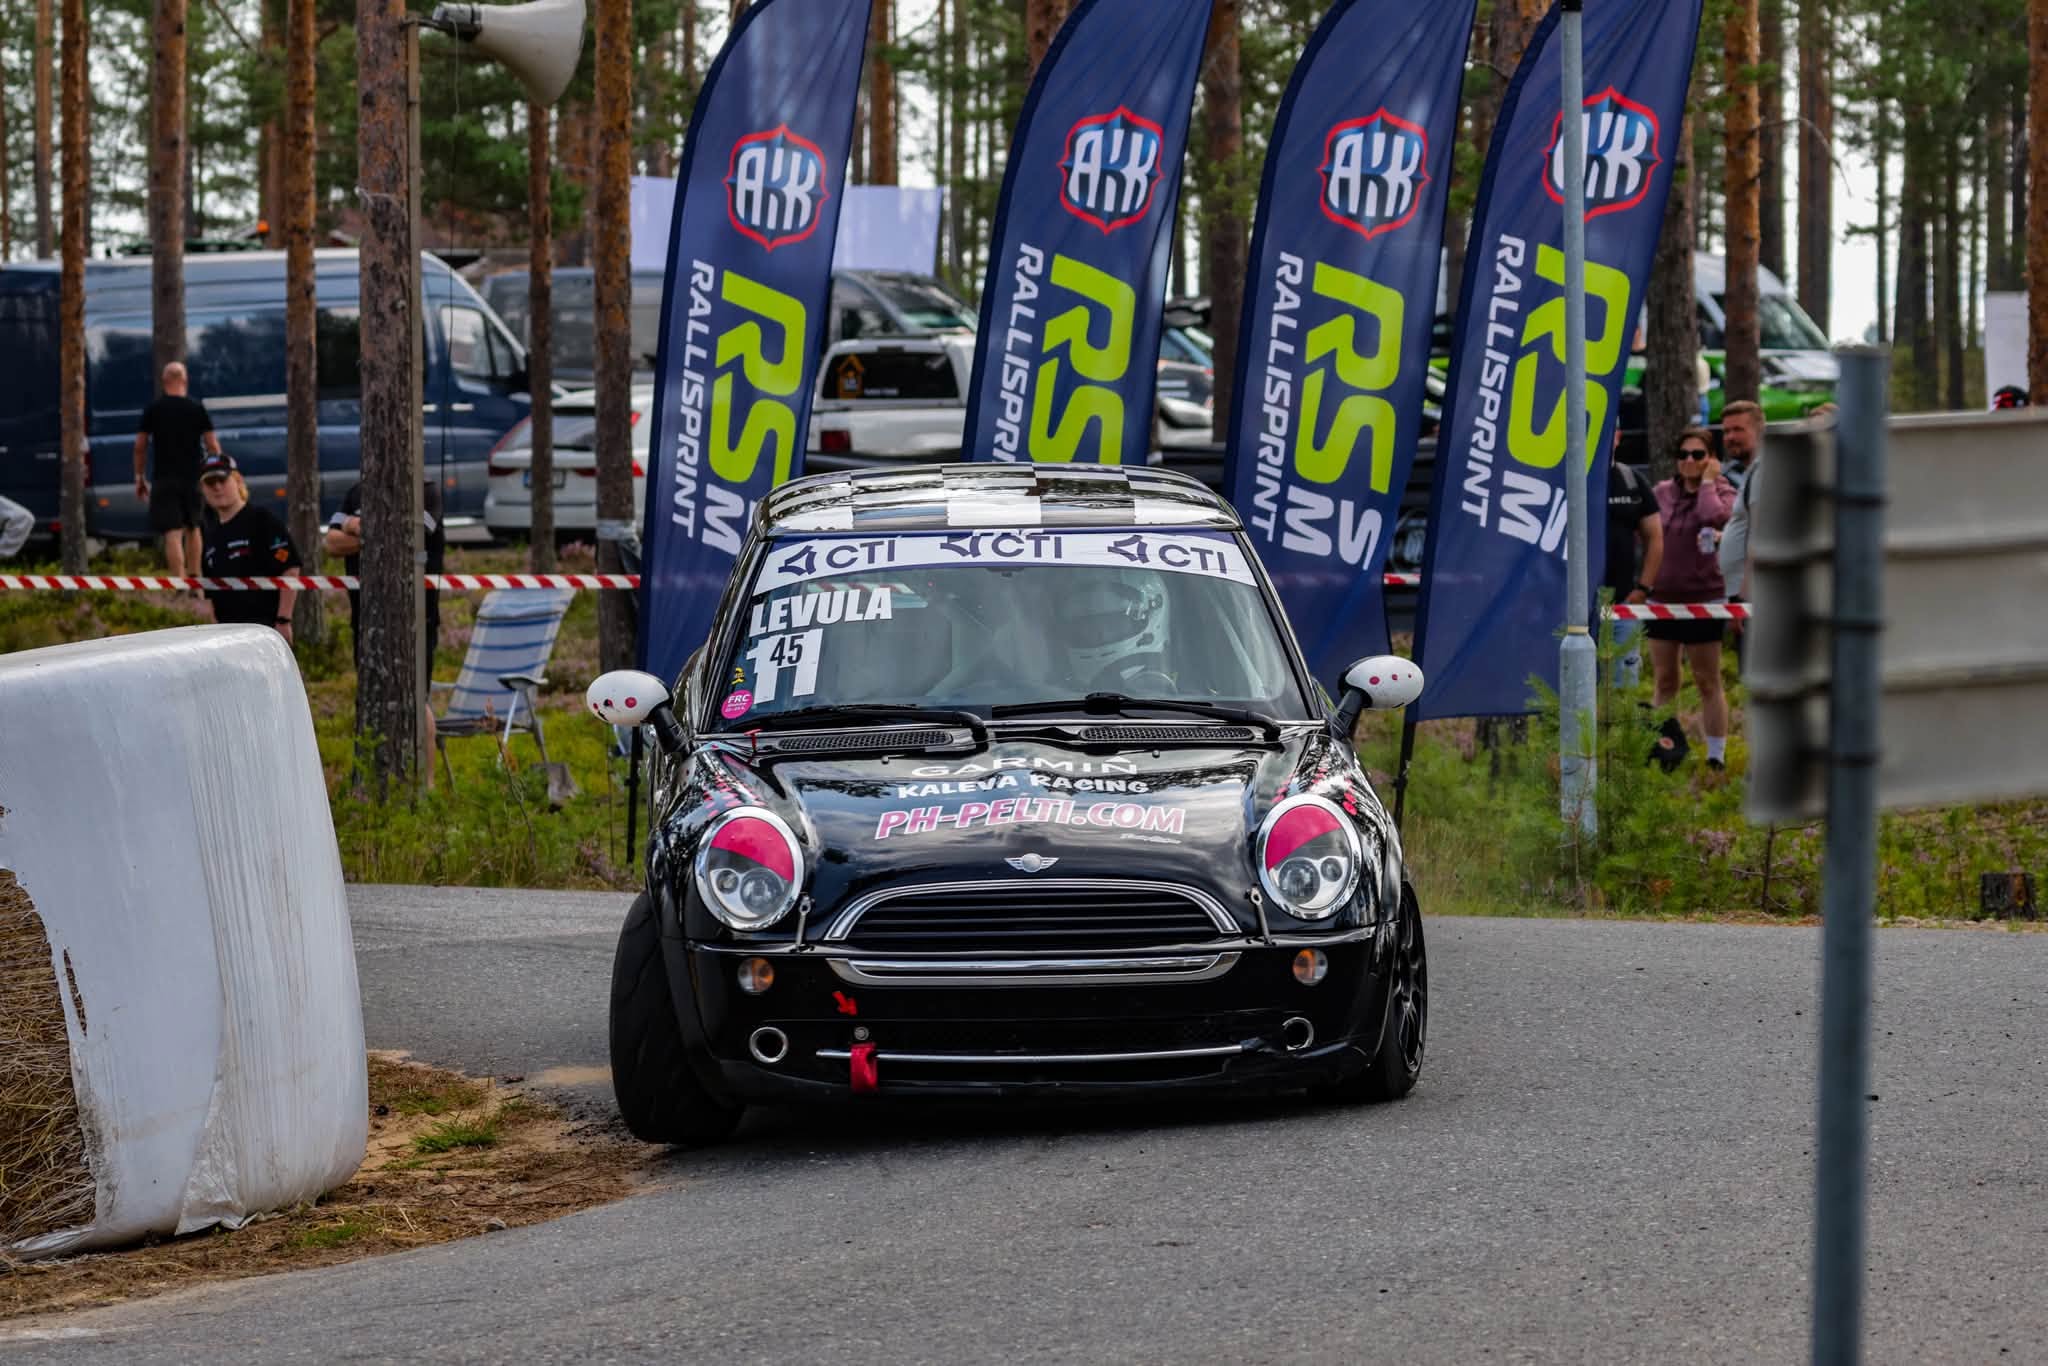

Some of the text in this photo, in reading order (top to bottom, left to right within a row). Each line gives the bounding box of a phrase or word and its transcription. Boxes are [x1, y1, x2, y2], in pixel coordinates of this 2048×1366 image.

[1251, 251, 1303, 542] RALLISPRINT
[1294, 261, 1404, 494] RS
[1462, 233, 1526, 528] RALLISPRINT
[672, 259, 715, 538] RALLISPRINT
[826, 540, 895, 569] CTI
[991, 534, 1062, 559] CTI
[1159, 544, 1227, 574] CTI
[749, 587, 893, 637] LEVULA
[746, 628, 823, 704] 11
[770, 634, 804, 666] 45
[727, 694, 751, 704] FRC
[898, 774, 1150, 799] KALEVA RACING
[912, 757, 1137, 778] GARMIN
[874, 796, 1186, 840] PH-PELTI.COM
